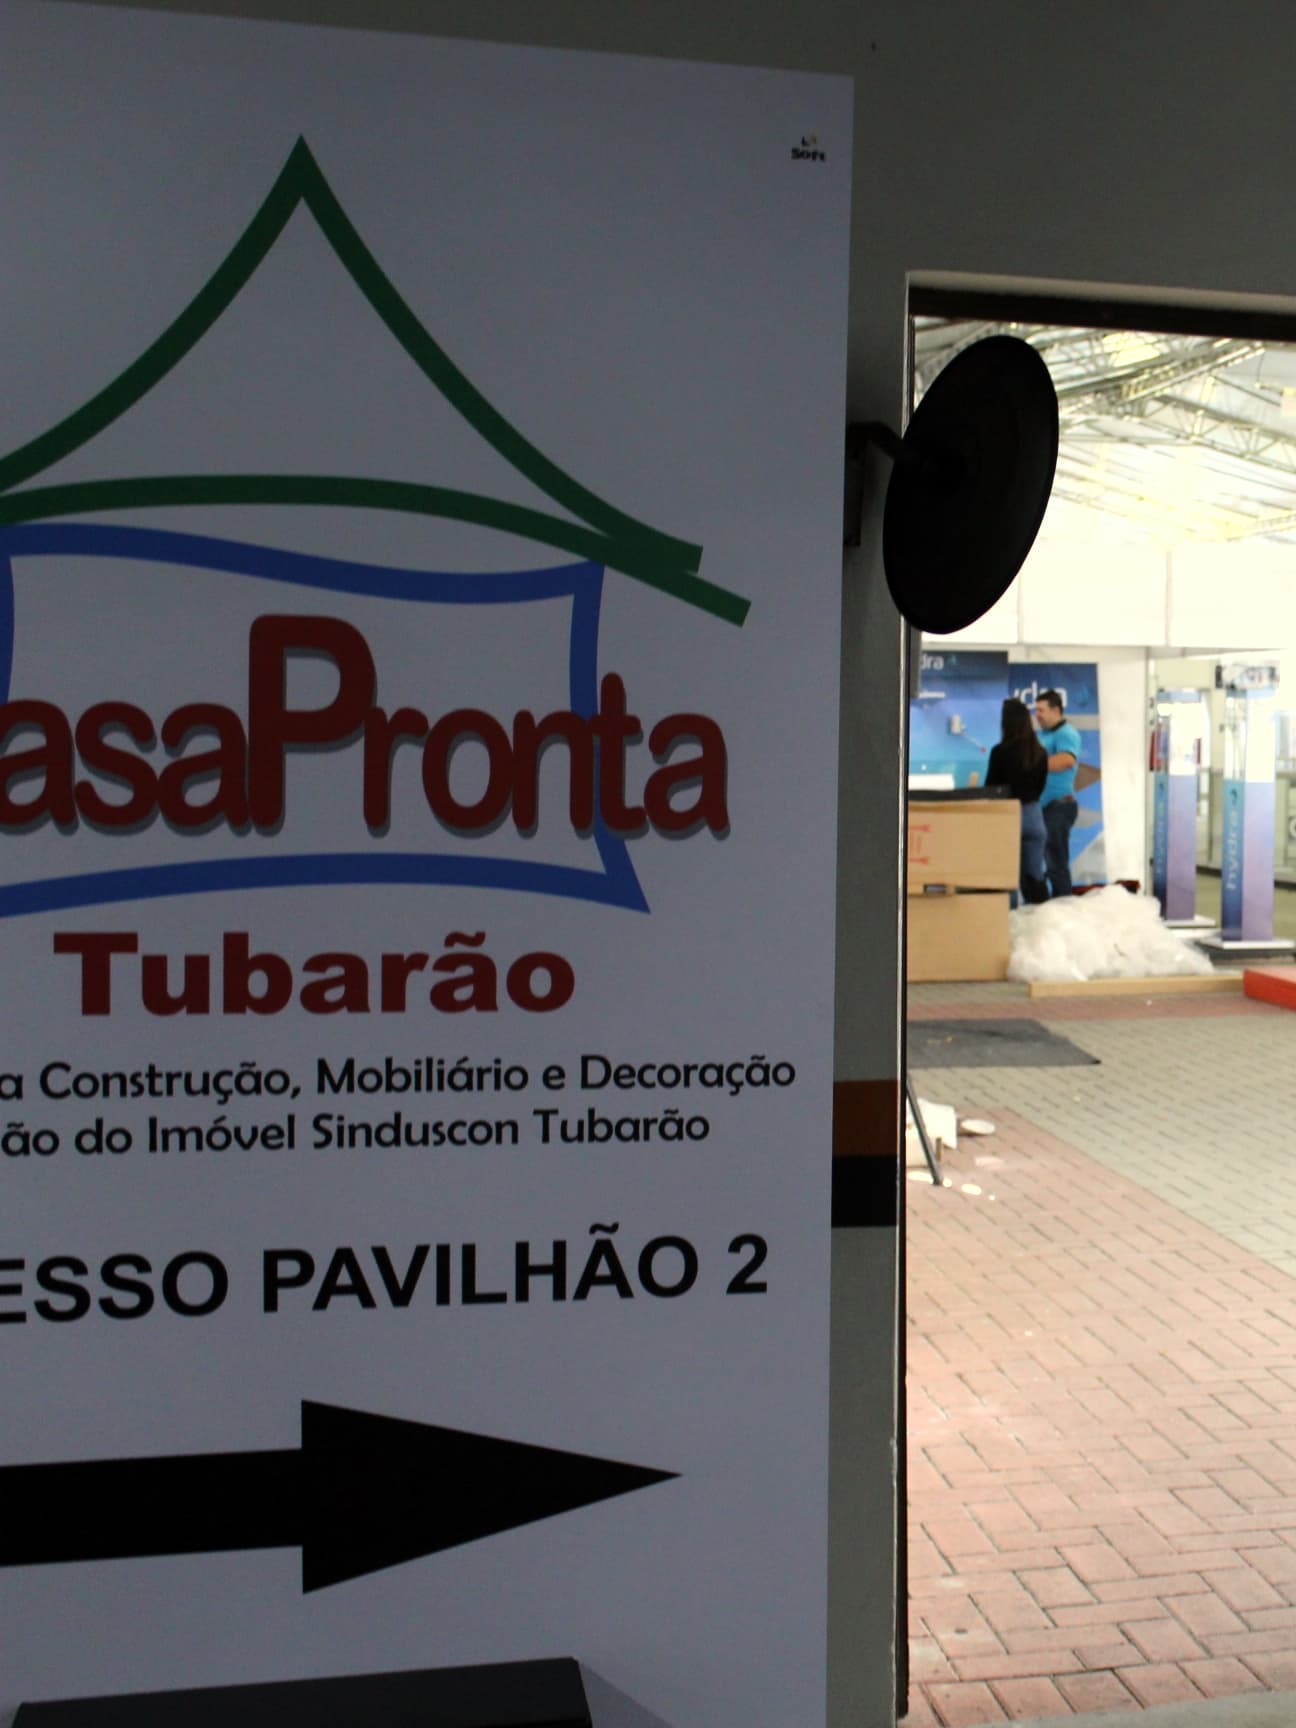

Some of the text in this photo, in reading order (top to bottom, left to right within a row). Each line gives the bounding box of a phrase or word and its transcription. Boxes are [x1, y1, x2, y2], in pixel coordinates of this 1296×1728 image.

[54, 931, 576, 1017] Tubarão
[40, 1061, 301, 1107] Construção,
[317, 1056, 530, 1097] Mobiliário
[543, 1065, 567, 1092] e
[580, 1055, 797, 1099] Decoração
[75, 1116, 134, 1157] do
[148, 1114, 297, 1154] Imóvel
[312, 1113, 520, 1151] Sinduscon
[533, 1109, 711, 1145] Tubarão
[0, 1223, 770, 1324] ESSO PAVILHÃO 2
